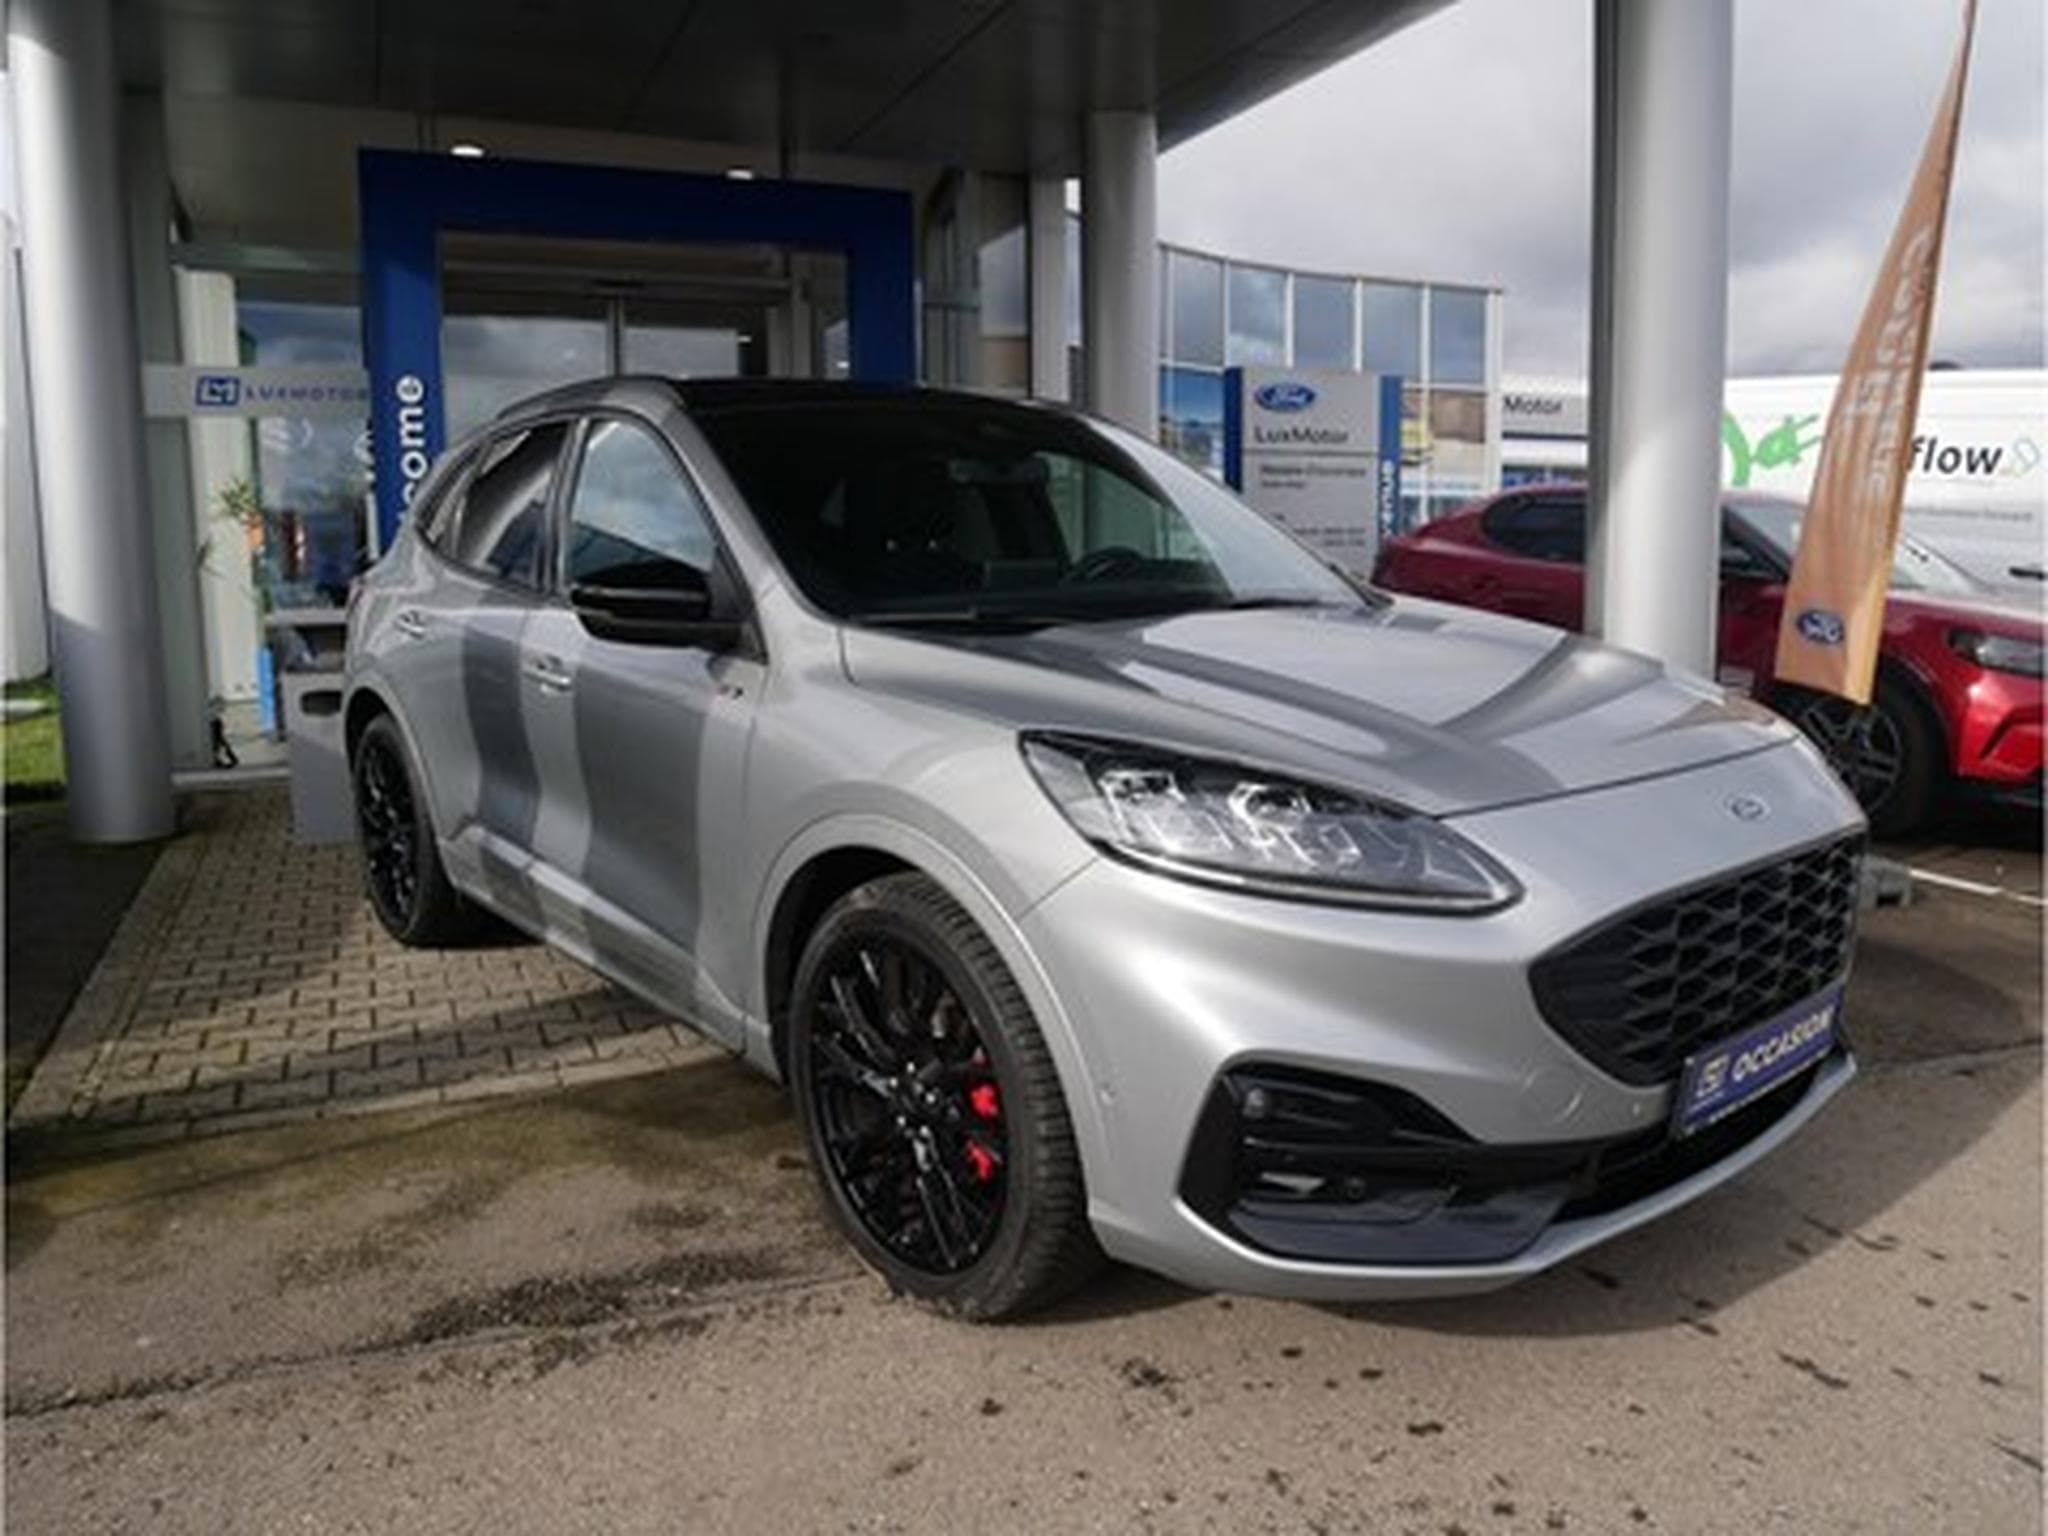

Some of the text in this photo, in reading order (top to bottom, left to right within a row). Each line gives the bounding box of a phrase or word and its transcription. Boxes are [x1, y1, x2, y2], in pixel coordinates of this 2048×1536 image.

[1504, 395, 1562, 415] Motor
[1253, 426, 1349, 444] LuxMotor
[395, 374, 428, 521] ome
